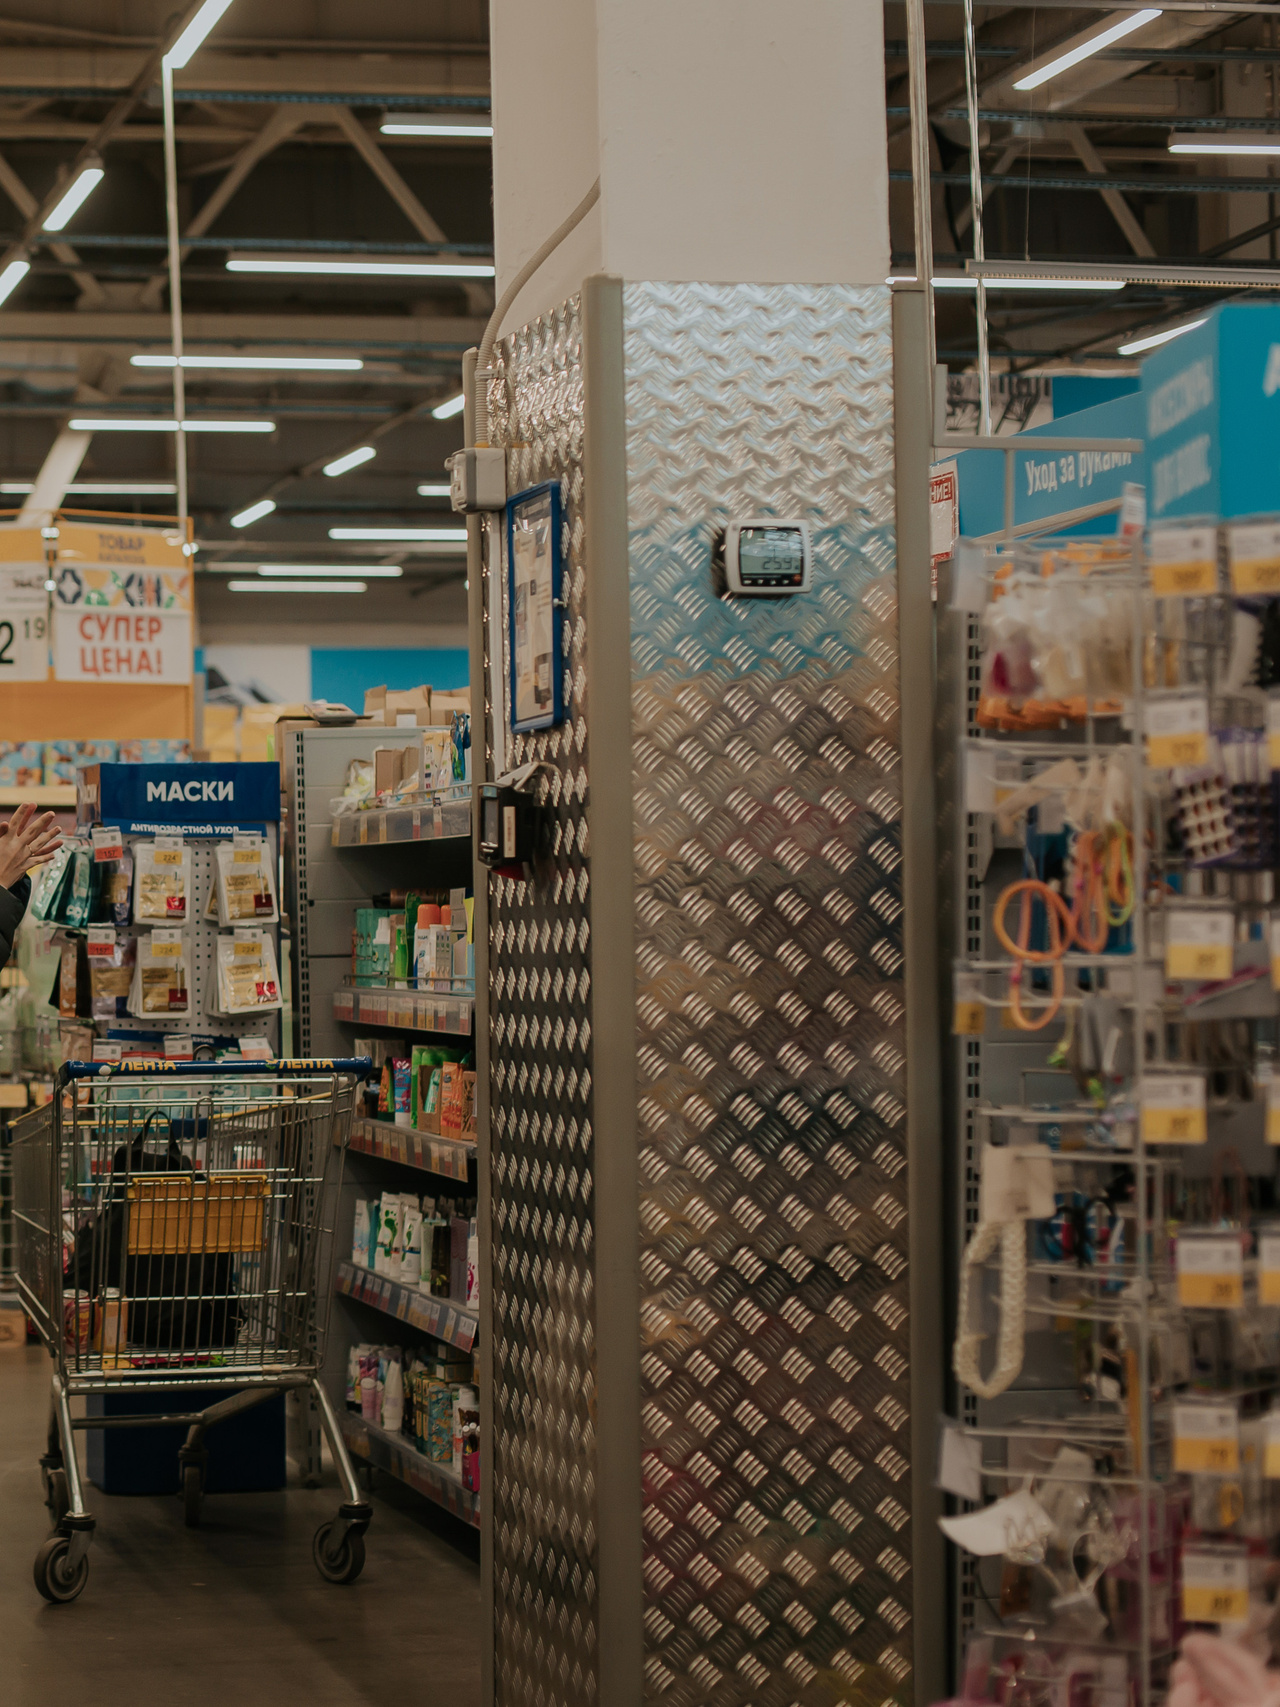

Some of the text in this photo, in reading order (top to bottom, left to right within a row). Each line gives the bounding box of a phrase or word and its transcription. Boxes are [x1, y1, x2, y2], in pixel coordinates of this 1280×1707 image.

[1025, 459, 1058, 497] Уход
[1059, 455, 1076, 485] за
[930, 481, 951, 503] НИЕ!
[98, 534, 145, 551] ТОВАР
[23, 617, 46, 640] 19
[78, 613, 162, 643] СУПЕР
[80, 646, 163, 678] ЦЕНА!
[146, 781, 234, 802] МАСКИ
[120, 1060, 177, 1072] ЛЕНТА
[278, 1059, 335, 1069] ЛЕНТА
